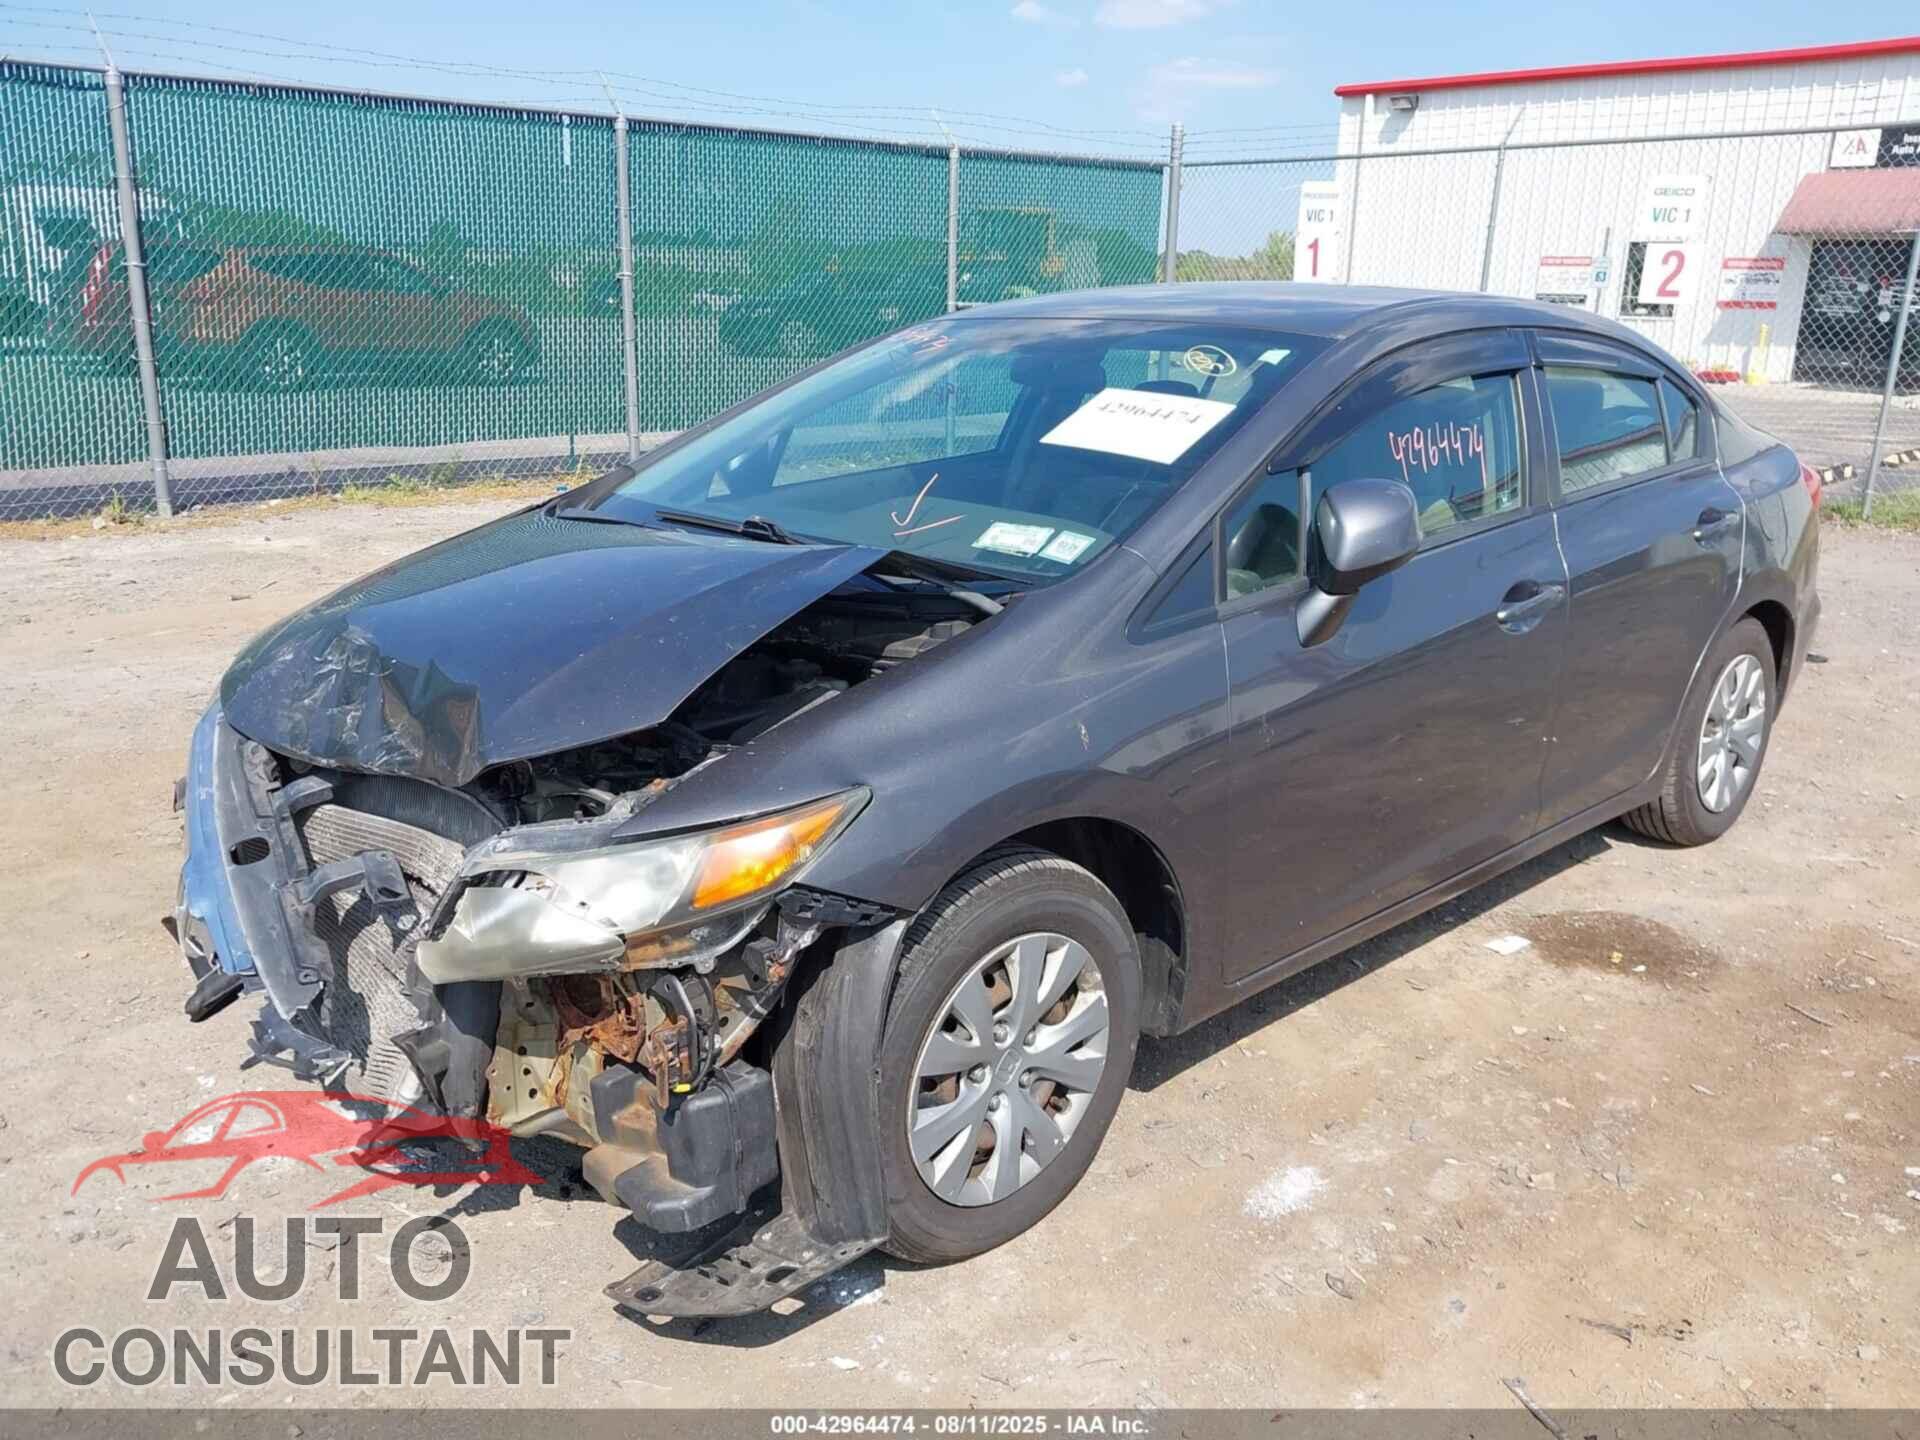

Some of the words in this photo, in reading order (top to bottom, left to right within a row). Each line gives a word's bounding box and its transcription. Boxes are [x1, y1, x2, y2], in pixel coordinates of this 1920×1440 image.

[1653, 187, 1695, 196] GEICO
[1306, 208, 1325, 222] VIC
[1329, 208, 1334, 222] 1
[1652, 207, 1678, 223] VIC
[1685, 208, 1691, 223] 1
[1307, 237, 1319, 277] 1
[1656, 250, 1685, 297] 2
[1388, 421, 1487, 490] 42964474
